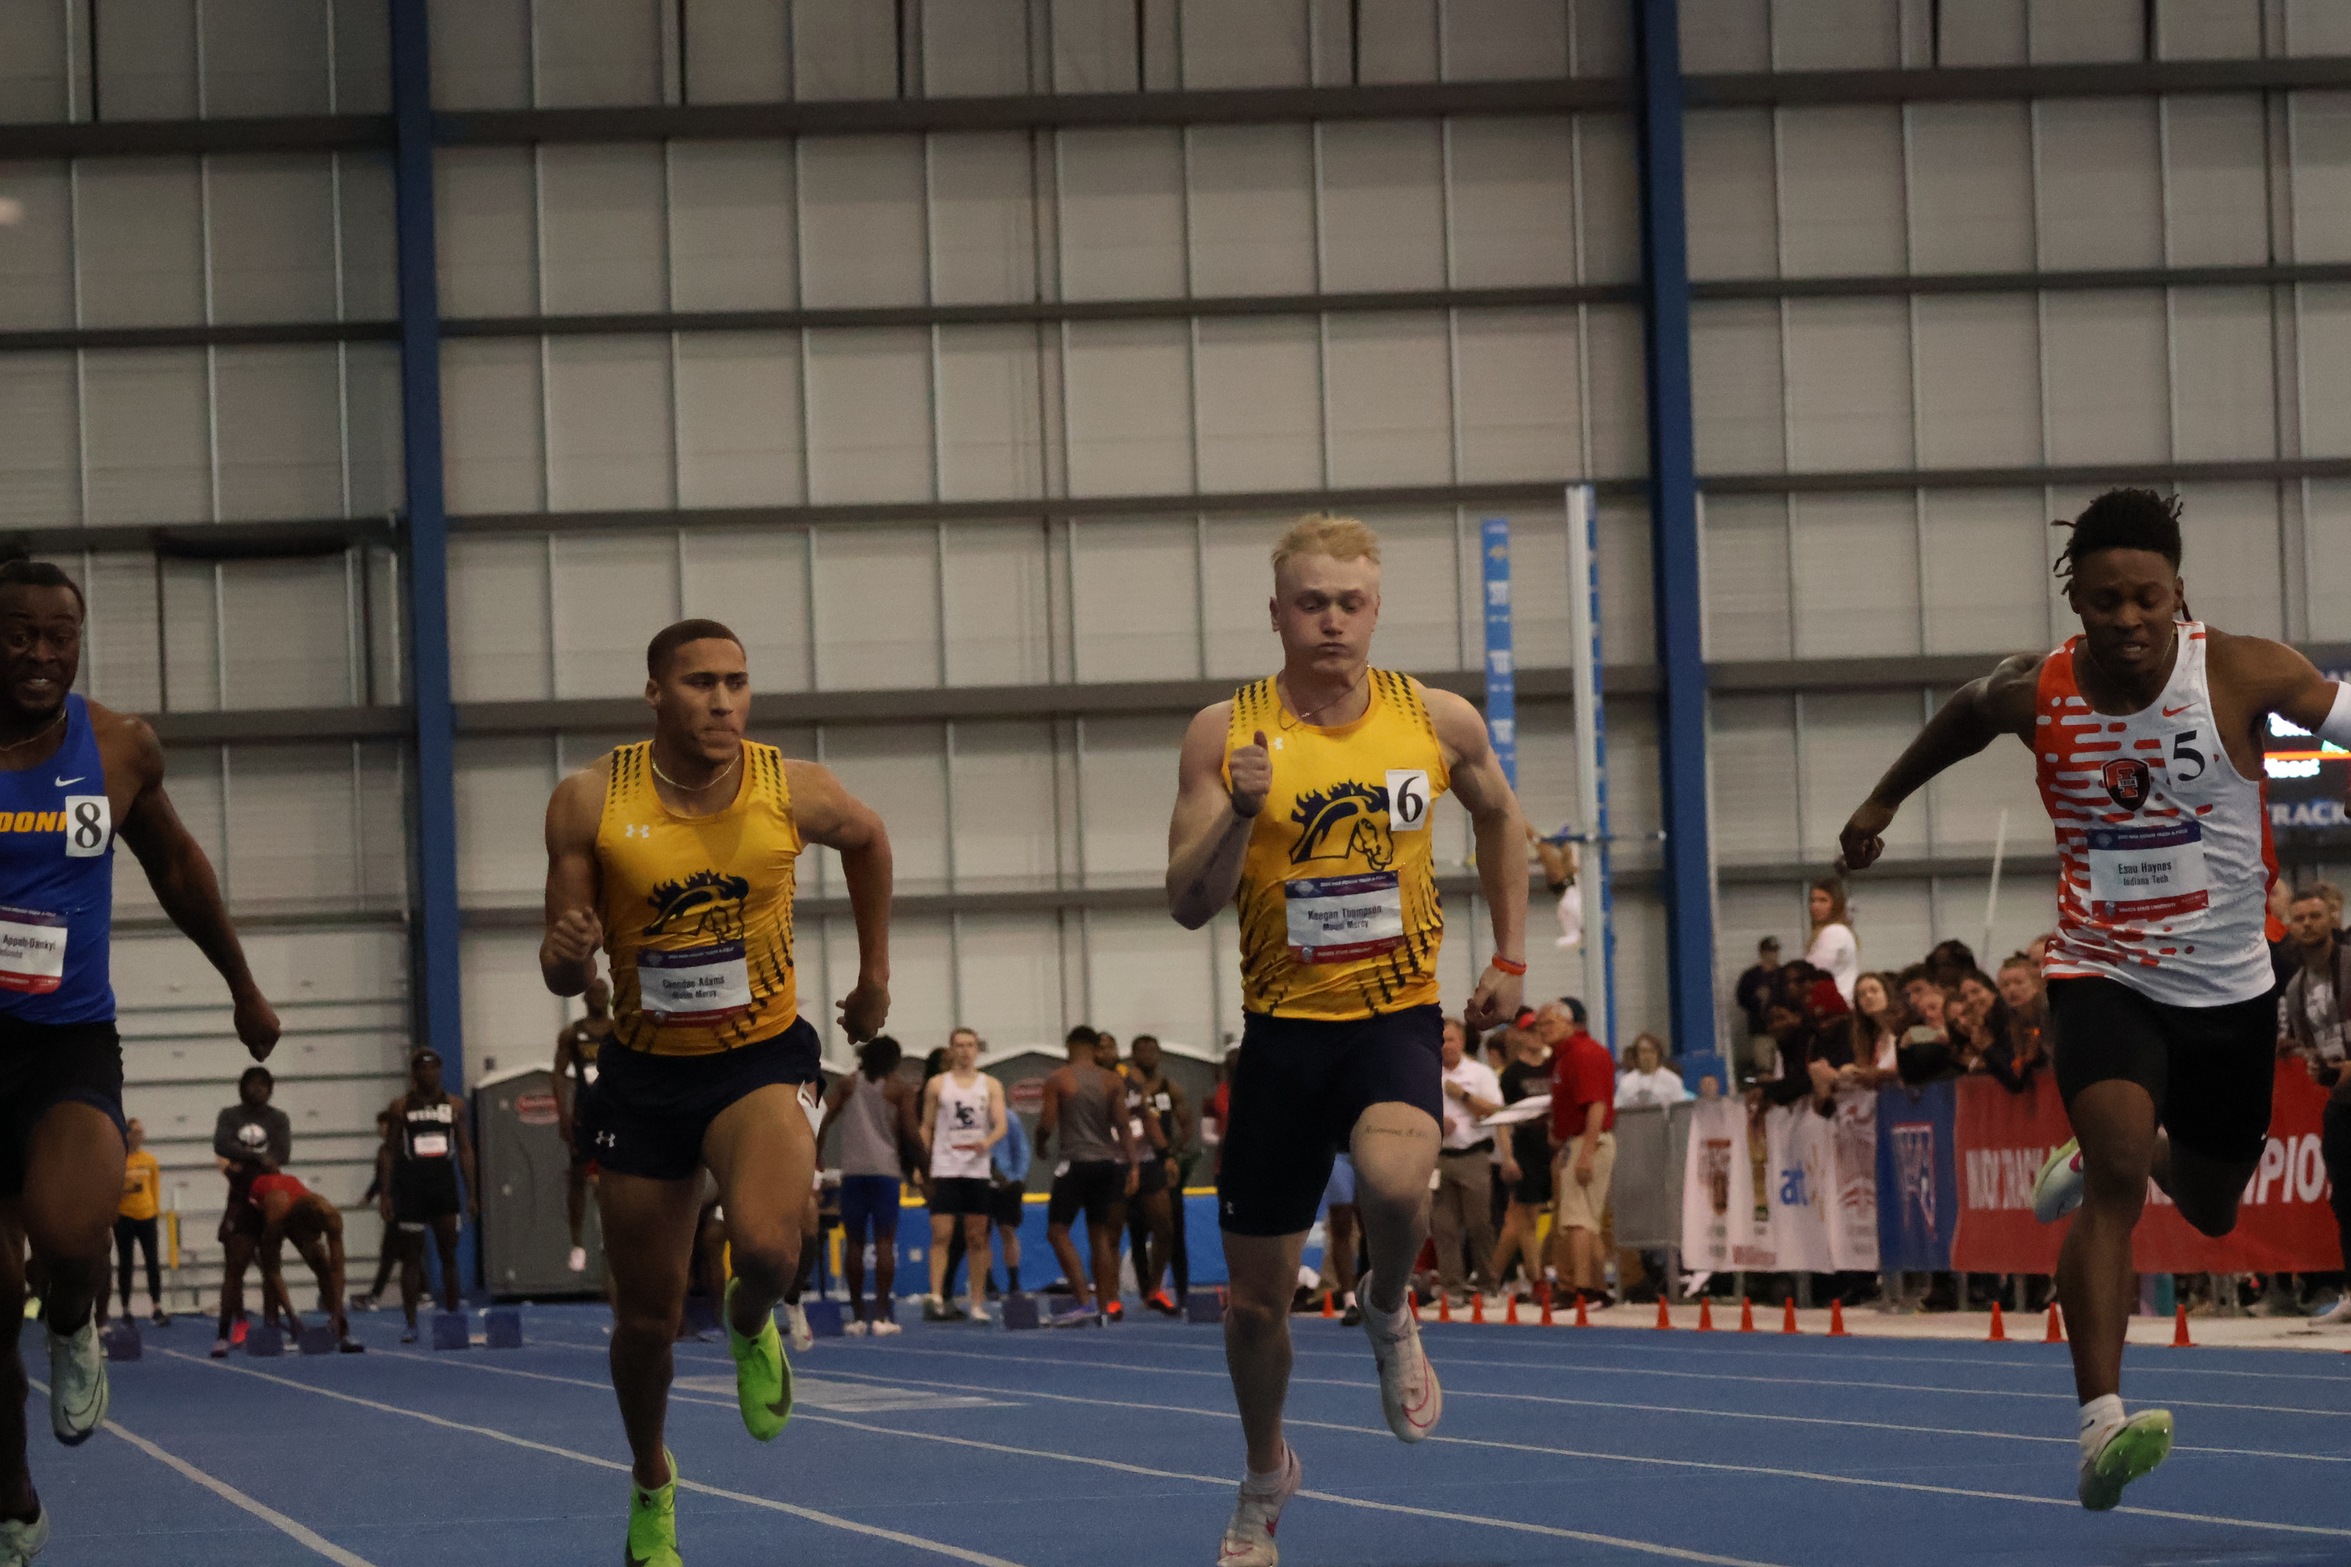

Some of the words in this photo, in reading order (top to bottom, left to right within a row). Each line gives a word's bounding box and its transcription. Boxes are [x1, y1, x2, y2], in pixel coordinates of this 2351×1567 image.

[2173, 730, 2206, 781] 5
[1397, 776, 1423, 823] 6
[2266, 802, 2347, 827] RACK
[74, 802, 102, 849] 8
[2118, 863, 2138, 874] Esau
[2141, 861, 2172, 875] Haynes
[2123, 876, 2149, 886] Indiana
[2152, 874, 2169, 884] Tech
[1308, 910, 1339, 922] Keegan
[1341, 905, 1382, 919] Thompson
[698, 975, 726, 987] Adams
